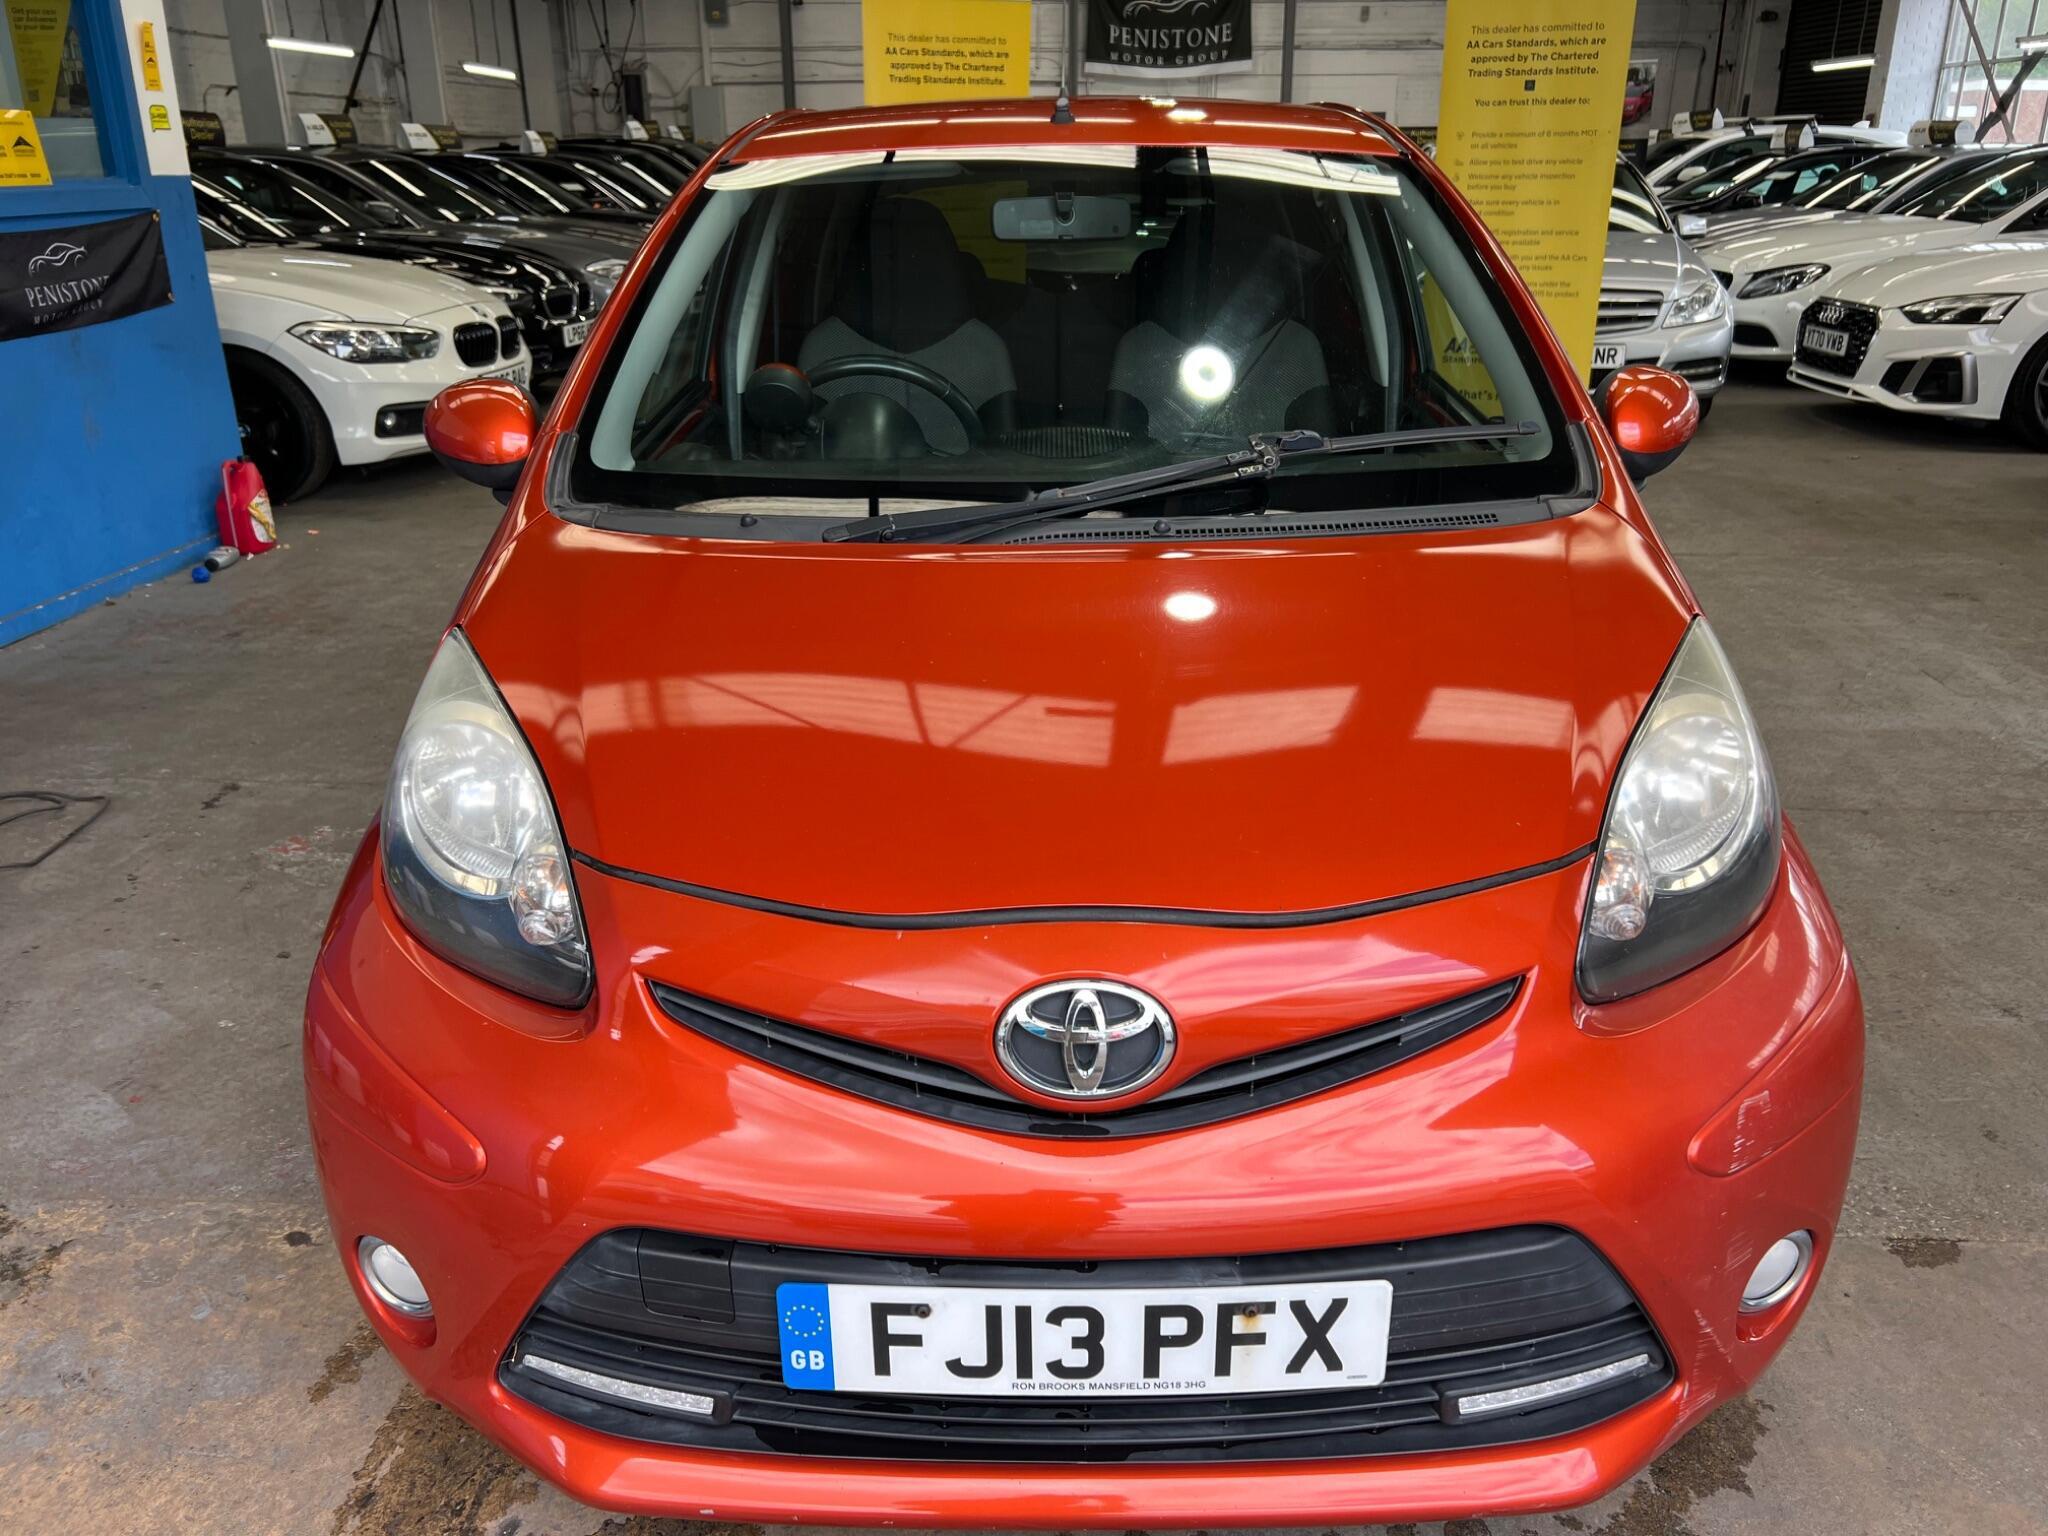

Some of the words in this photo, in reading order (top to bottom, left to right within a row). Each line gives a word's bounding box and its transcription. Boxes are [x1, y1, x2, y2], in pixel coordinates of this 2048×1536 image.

[1472, 25, 1490, 35] This
[1492, 24, 1521, 34] dealer
[1523, 24, 1539, 32] has
[1541, 22, 1593, 32] committed
[1595, 22, 1605, 30] to
[888, 33, 906, 42] This
[908, 34, 934, 43] dealer
[935, 34, 950, 43] has
[952, 35, 996, 45] committed
[998, 37, 1007, 45] to
[1109, 23, 1233, 49] PENISTONE
[1466, 40, 1480, 49] AA
[1482, 40, 1504, 49] Cars
[1506, 38, 1557, 48] Standards,
[1560, 37, 1589, 46] which
[885, 47, 898, 55] AA
[899, 47, 919, 56] Cars
[921, 48, 967, 58] Standards,
[969, 50, 994, 58] which
[996, 51, 1009, 59] are
[1110, 51, 1164, 65] MOTOR
[1175, 50, 1229, 65] GROUP
[1471, 53, 1515, 65] approved
[1517, 52, 1529, 64] by
[1531, 52, 1548, 61] The
[1551, 50, 1599, 61] Chartered
[890, 62, 930, 71] approved
[932, 62, 943, 71] by
[944, 62, 961, 70] The
[962, 63, 1005, 72] Chartered
[1468, 68, 1503, 79] Trading
[1505, 67, 1553, 77] Standards
[1556, 66, 1599, 75] Institute.
[889, 74, 921, 85] Trading
[923, 75, 966, 84] Standards
[1474, 99, 1490, 107] You
[1492, 99, 1507, 107] can
[1509, 98, 1529, 106] trust
[1532, 97, 1547, 105] this
[1549, 97, 1577, 105] dealer
[1578, 97, 1591, 105] to:
[1504, 130, 1536, 138] minimum
[1553, 129, 1580, 137] months
[1469, 158, 1488, 166] Allow
[1545, 159, 1556, 167] any
[1541, 228, 1555, 236] and
[1572, 254, 1588, 262] Cars
[25, 275, 109, 308] PENISTON
[1594, 347, 1617, 364] NR
[869, 1302, 1106, 1380] FJ13
[1142, 1297, 1349, 1379] PFX
[790, 1350, 825, 1371] GB
[1011, 1382, 1036, 1390] RON
[1038, 1382, 1086, 1391] BROOKS
[1088, 1382, 1151, 1391] MANSFIELD
[1153, 1381, 1182, 1390] NG18
[1184, 1380, 1207, 1389] 3HG
